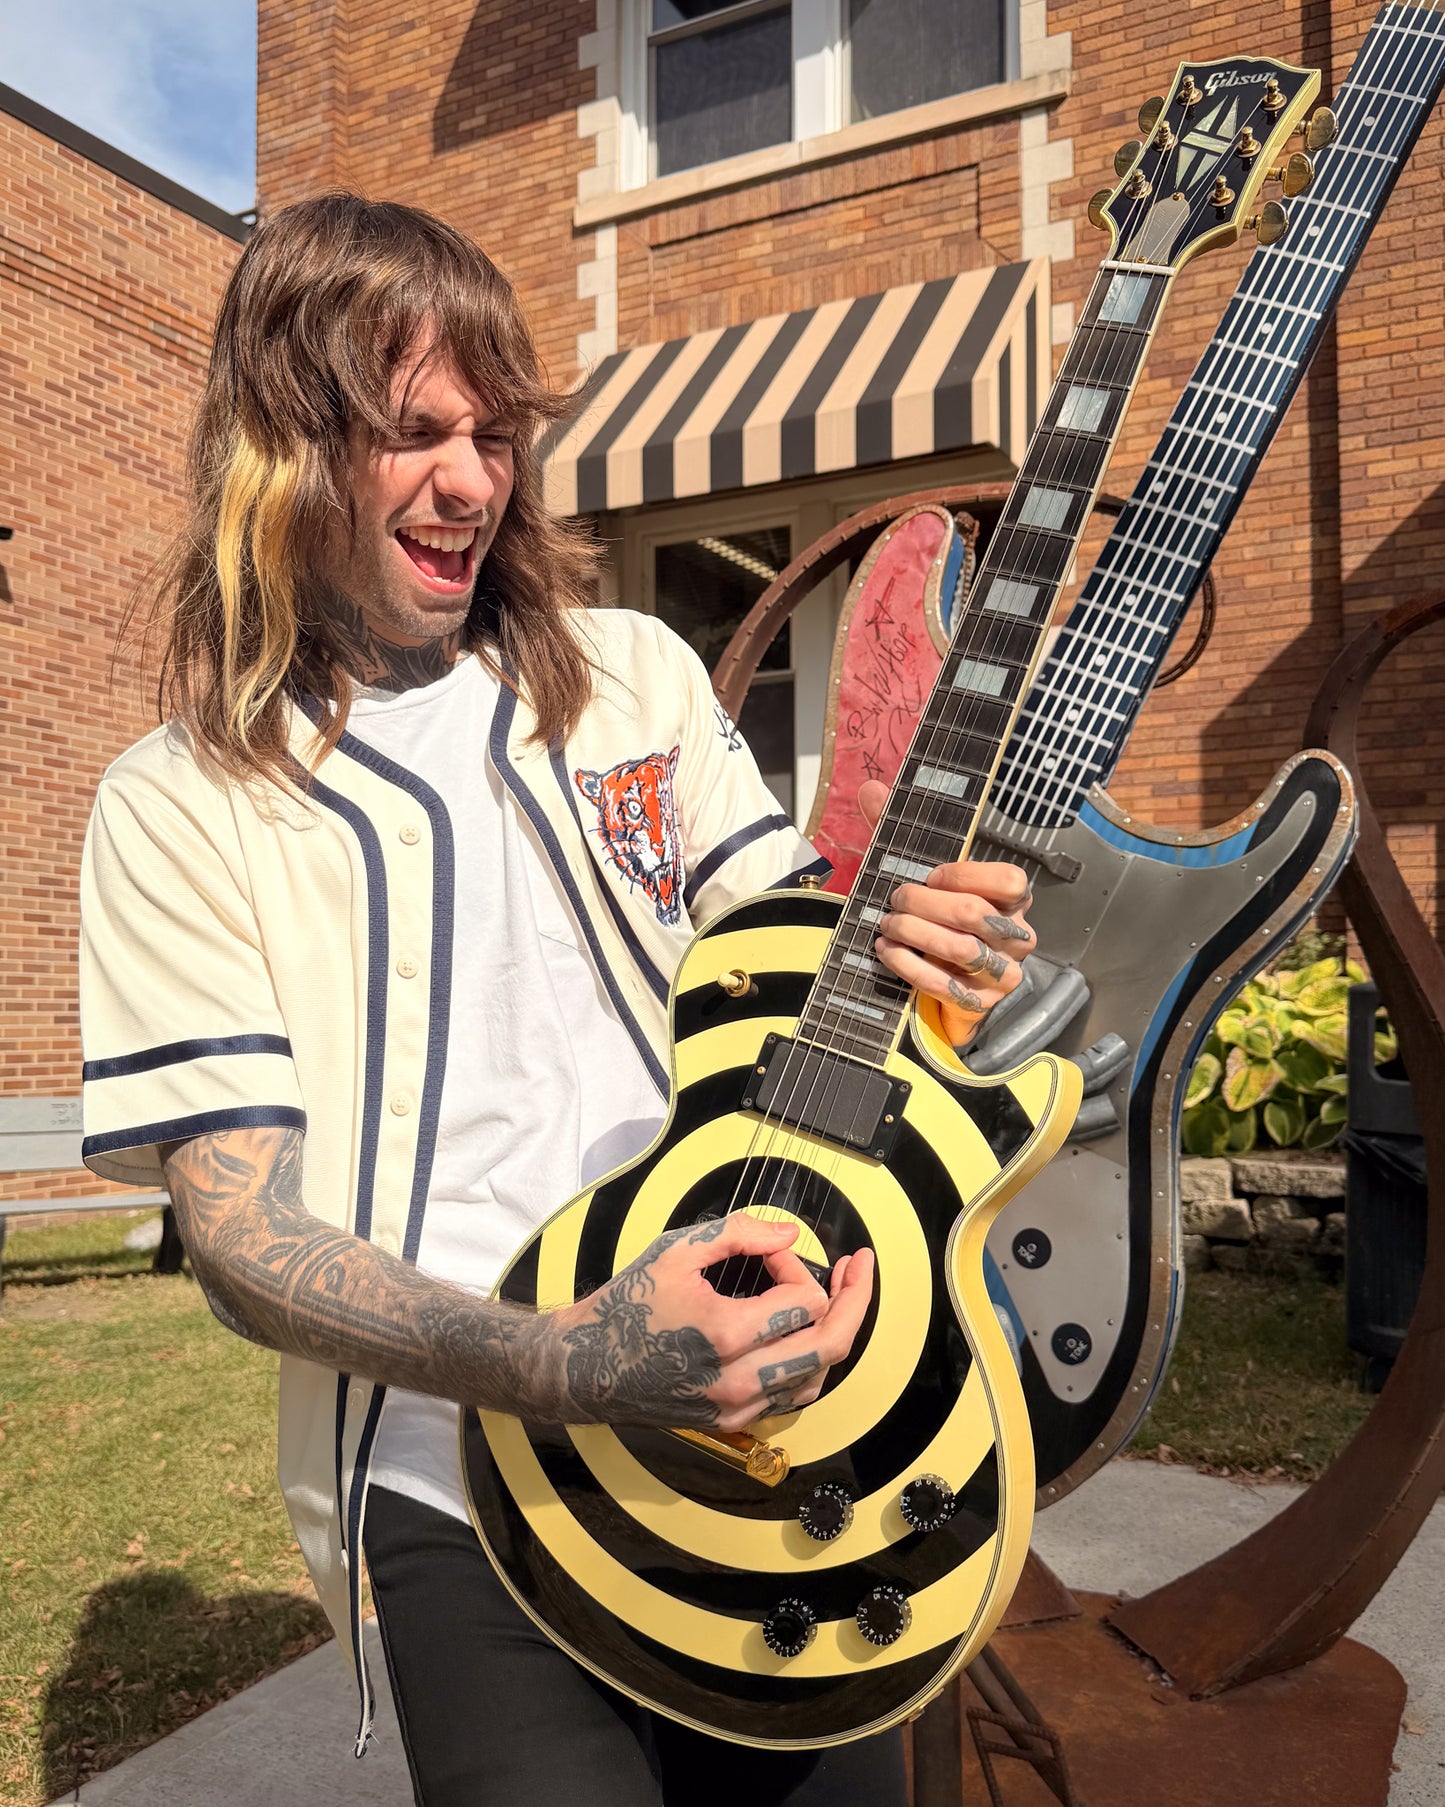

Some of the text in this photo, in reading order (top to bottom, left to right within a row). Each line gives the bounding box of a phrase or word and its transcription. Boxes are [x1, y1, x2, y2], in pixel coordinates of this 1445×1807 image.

[1204, 70, 1278, 96] Gibson
[1017, 1246, 1036, 1262] TONE
[1070, 1340, 1088, 1360] TONE
